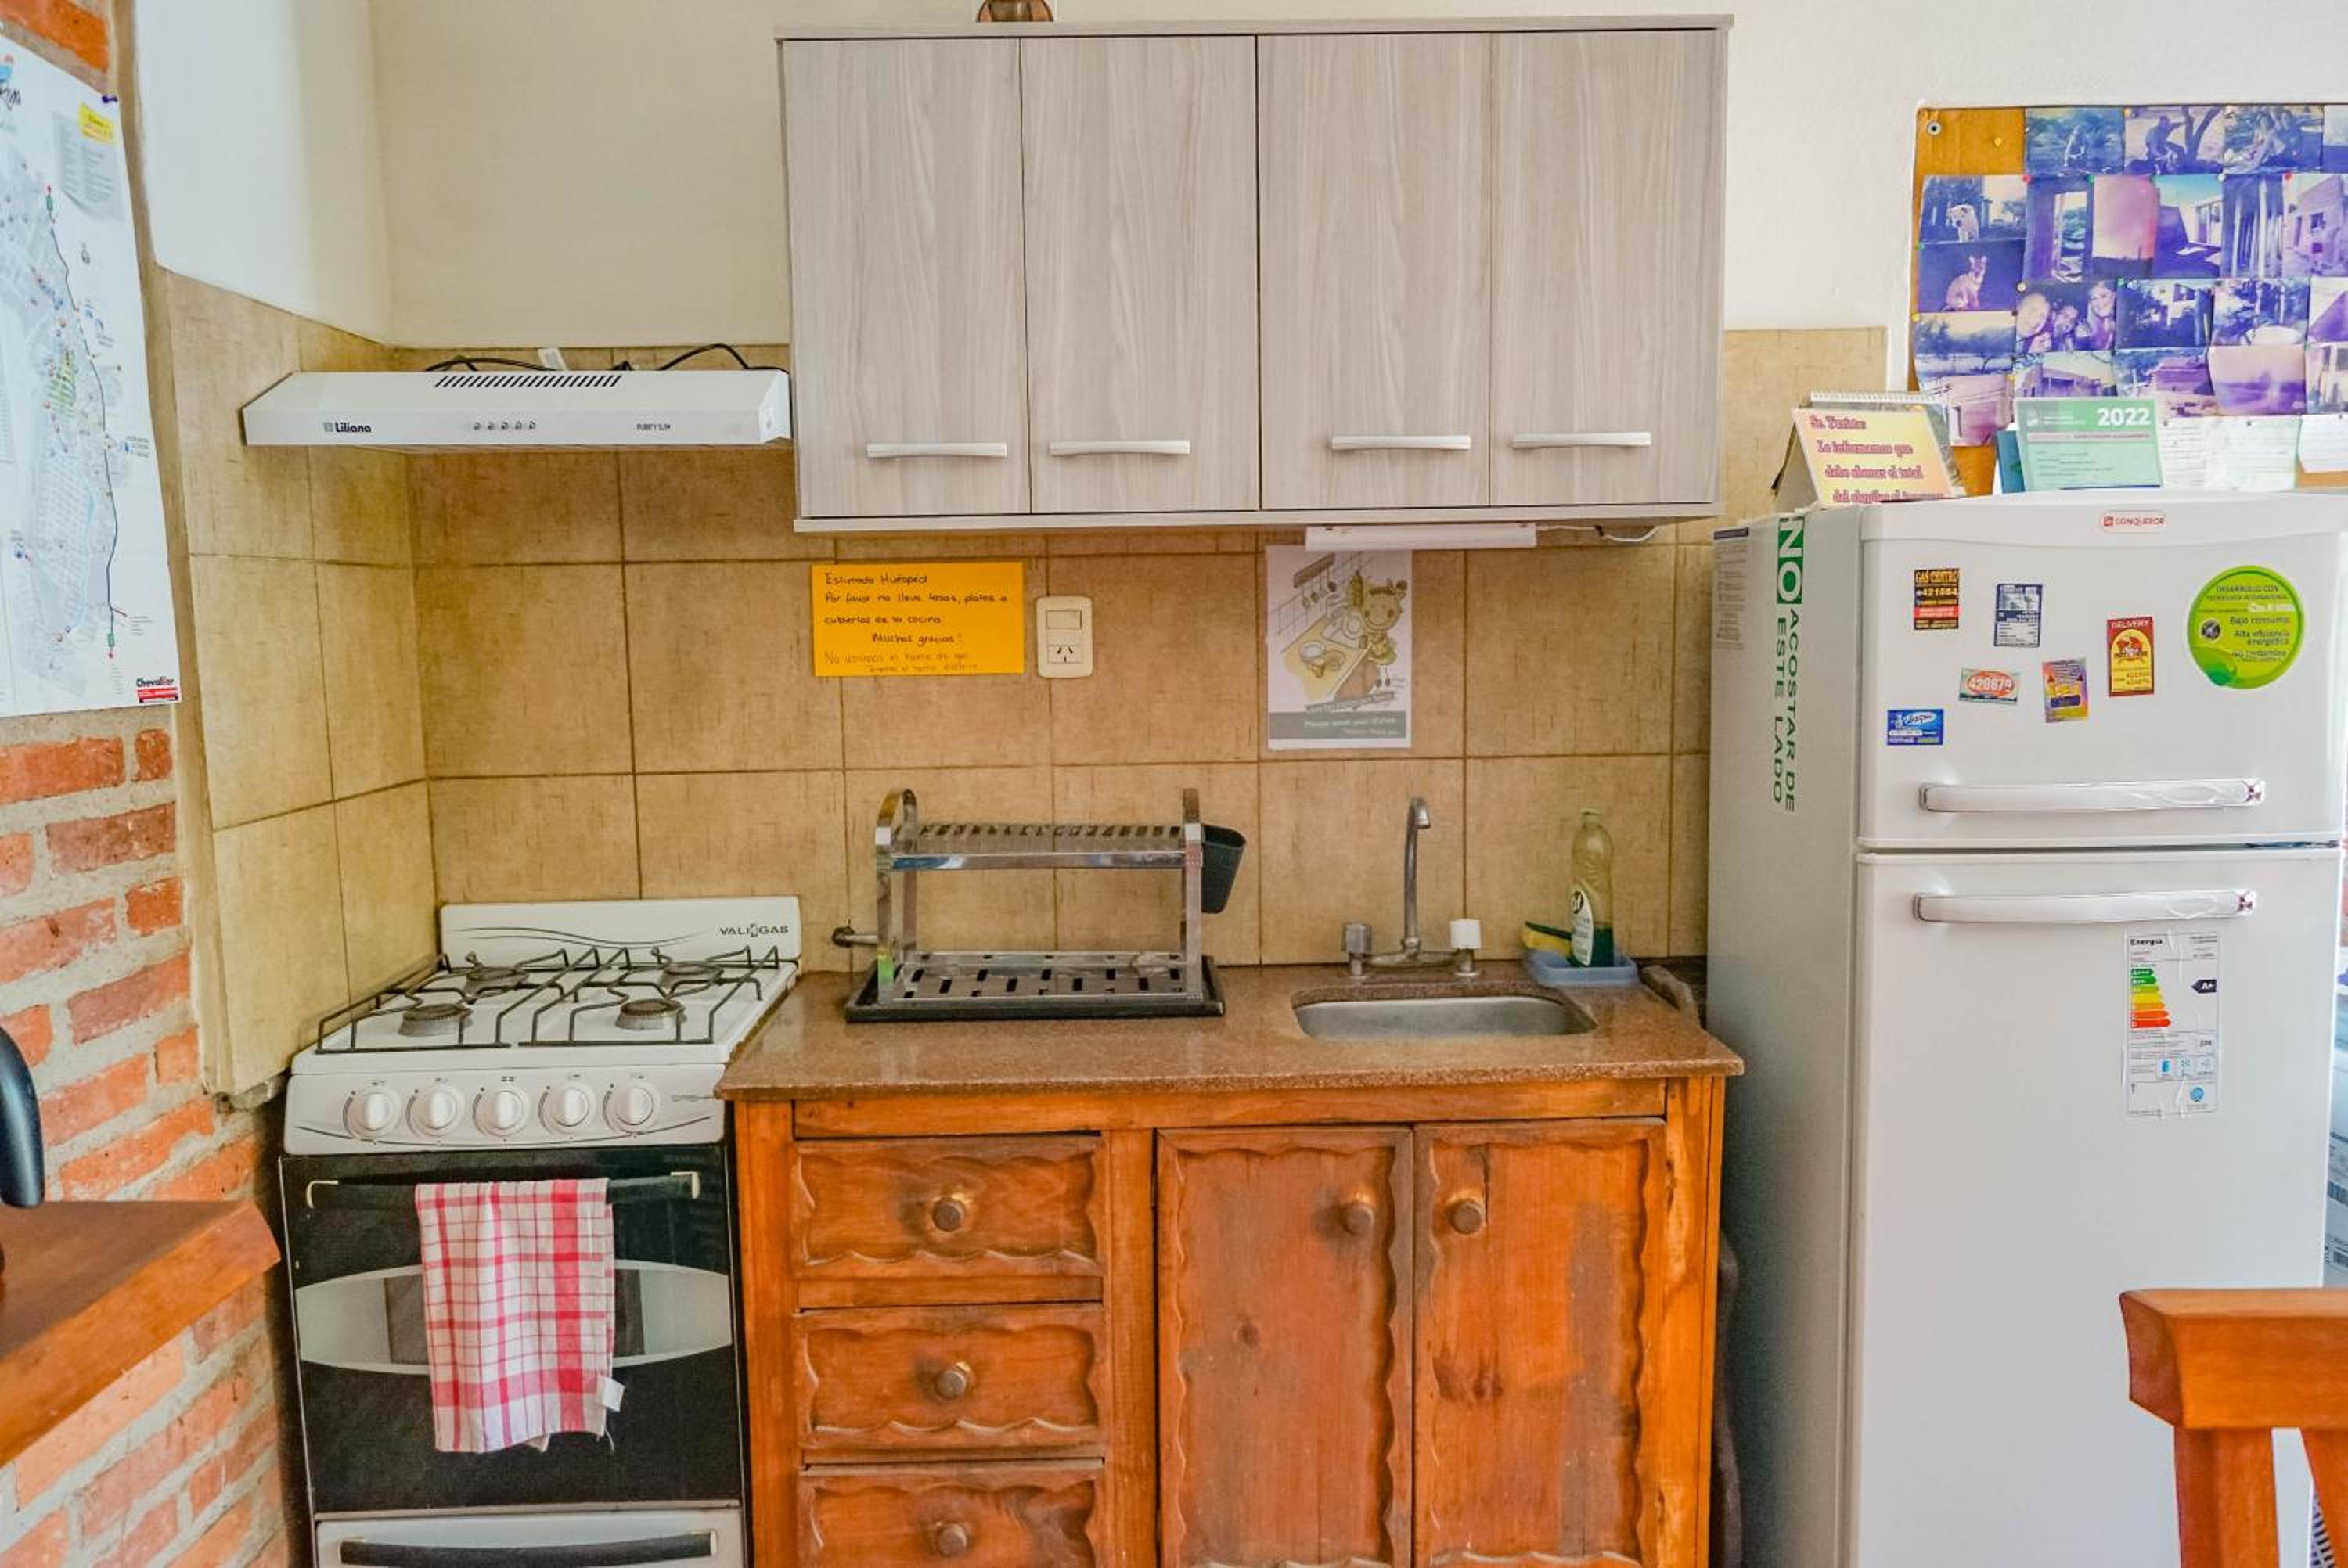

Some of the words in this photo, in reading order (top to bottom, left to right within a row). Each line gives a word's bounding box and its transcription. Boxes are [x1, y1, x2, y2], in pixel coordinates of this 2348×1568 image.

[335, 422, 372, 433] Liliana
[2096, 408, 2152, 427] 2022
[2115, 516, 2165, 526] CONQUEROR
[1778, 520, 1804, 602] NO
[1774, 617, 1787, 698] ESTE
[1786, 608, 1799, 761] ACOSTAR
[1773, 716, 1784, 803] LADO
[1785, 771, 1795, 812] DE
